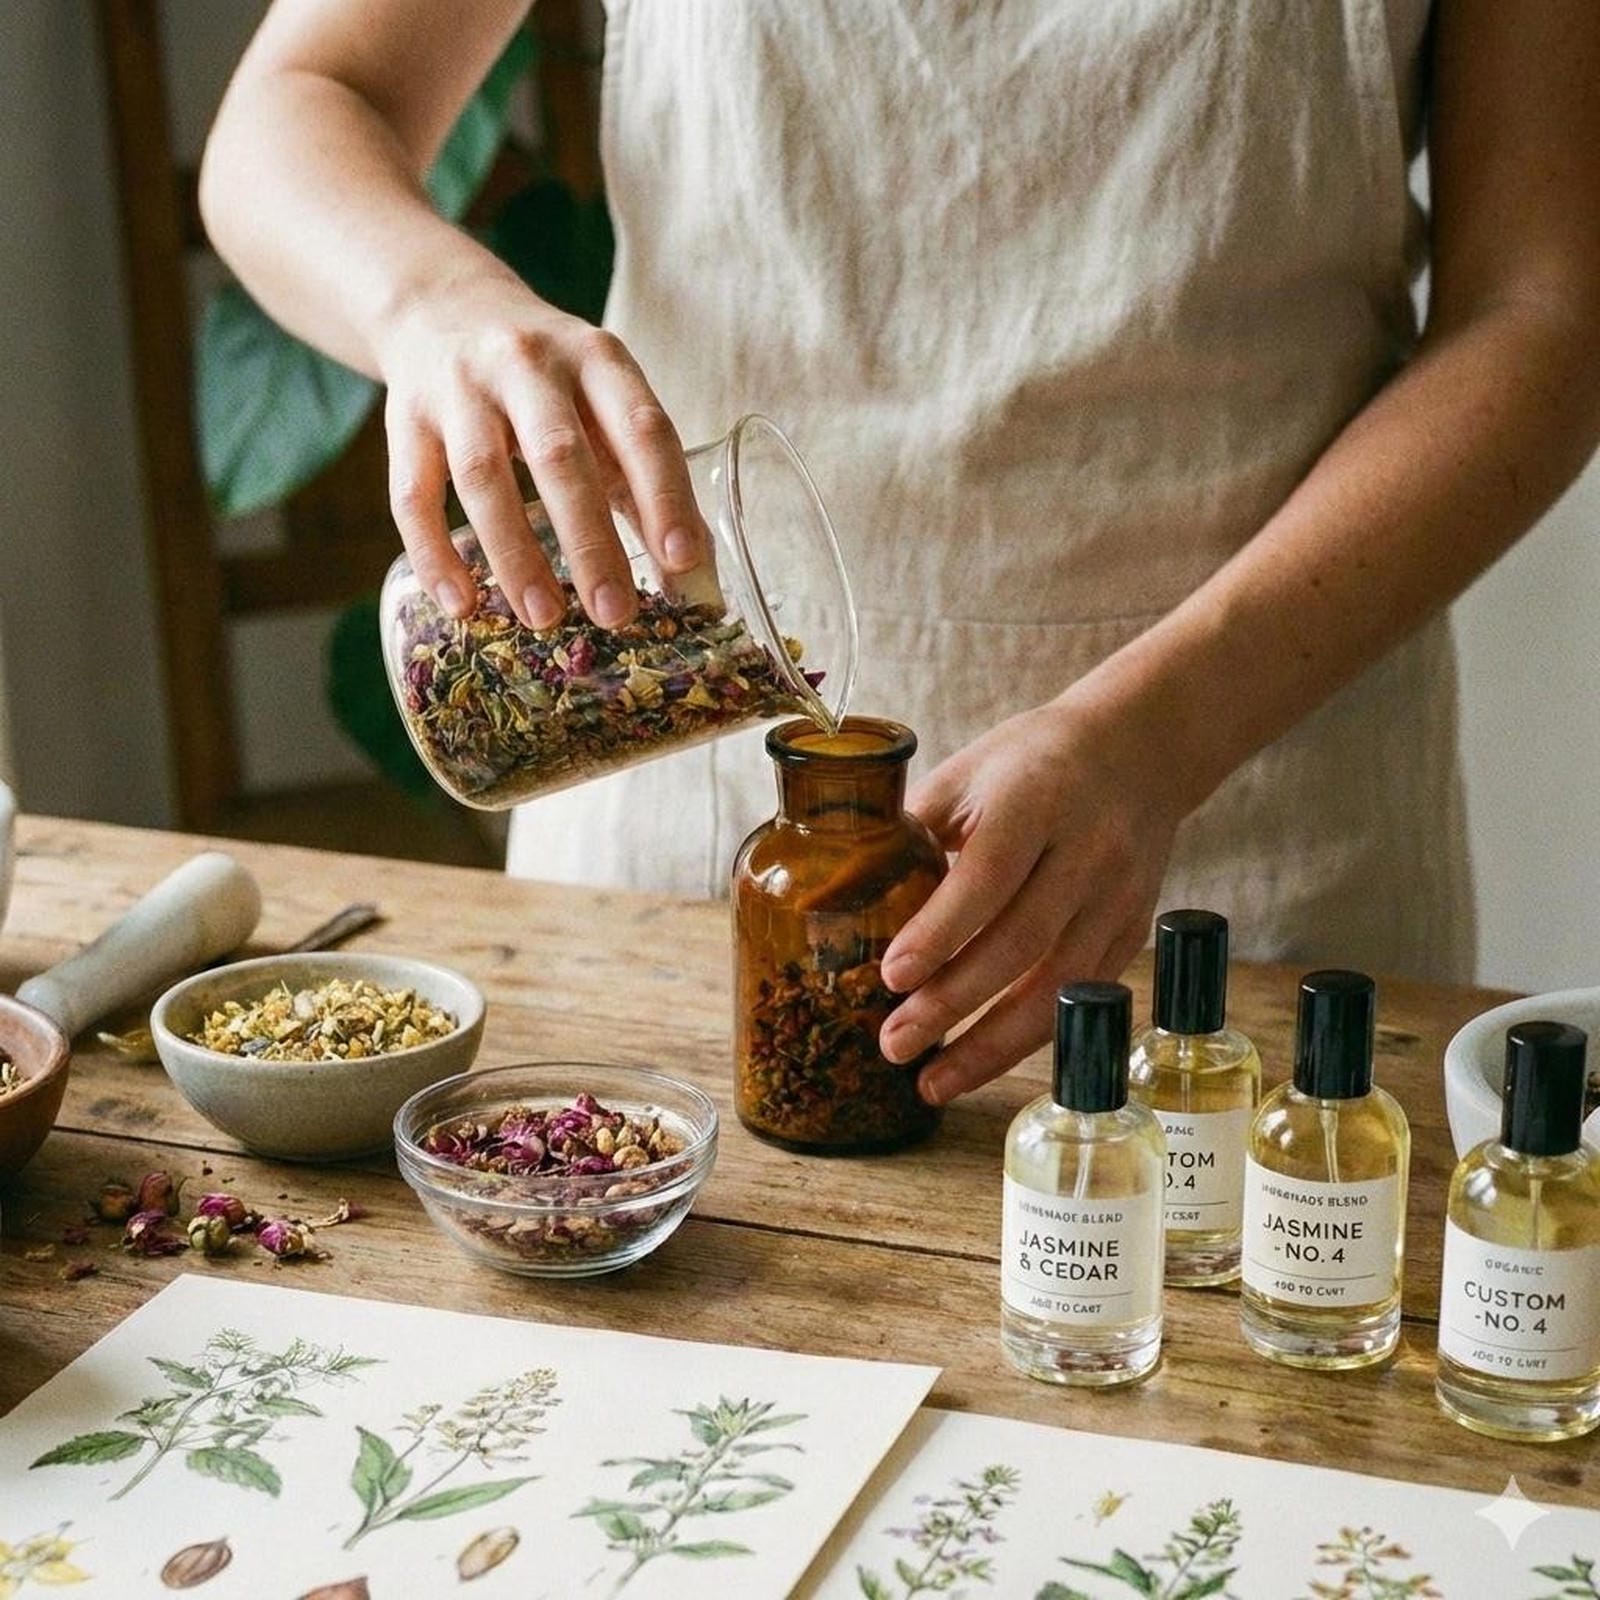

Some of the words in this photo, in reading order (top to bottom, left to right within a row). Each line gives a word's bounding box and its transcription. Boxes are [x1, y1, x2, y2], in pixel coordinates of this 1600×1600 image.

[1167, 1152, 1215, 1168] TOM
[1184, 1174, 1195, 1190] 4
[1262, 1213, 1364, 1240] JASMINE
[1020, 1230, 1120, 1258] JASMINE
[1331, 1247, 1346, 1263] 4
[1020, 1252, 1031, 1271] &
[1039, 1258, 1118, 1281] CEDAR
[1464, 1281, 1565, 1311] CUSTOM
[1055, 1302, 1070, 1313] TO
[1532, 1318, 1548, 1334] 4
